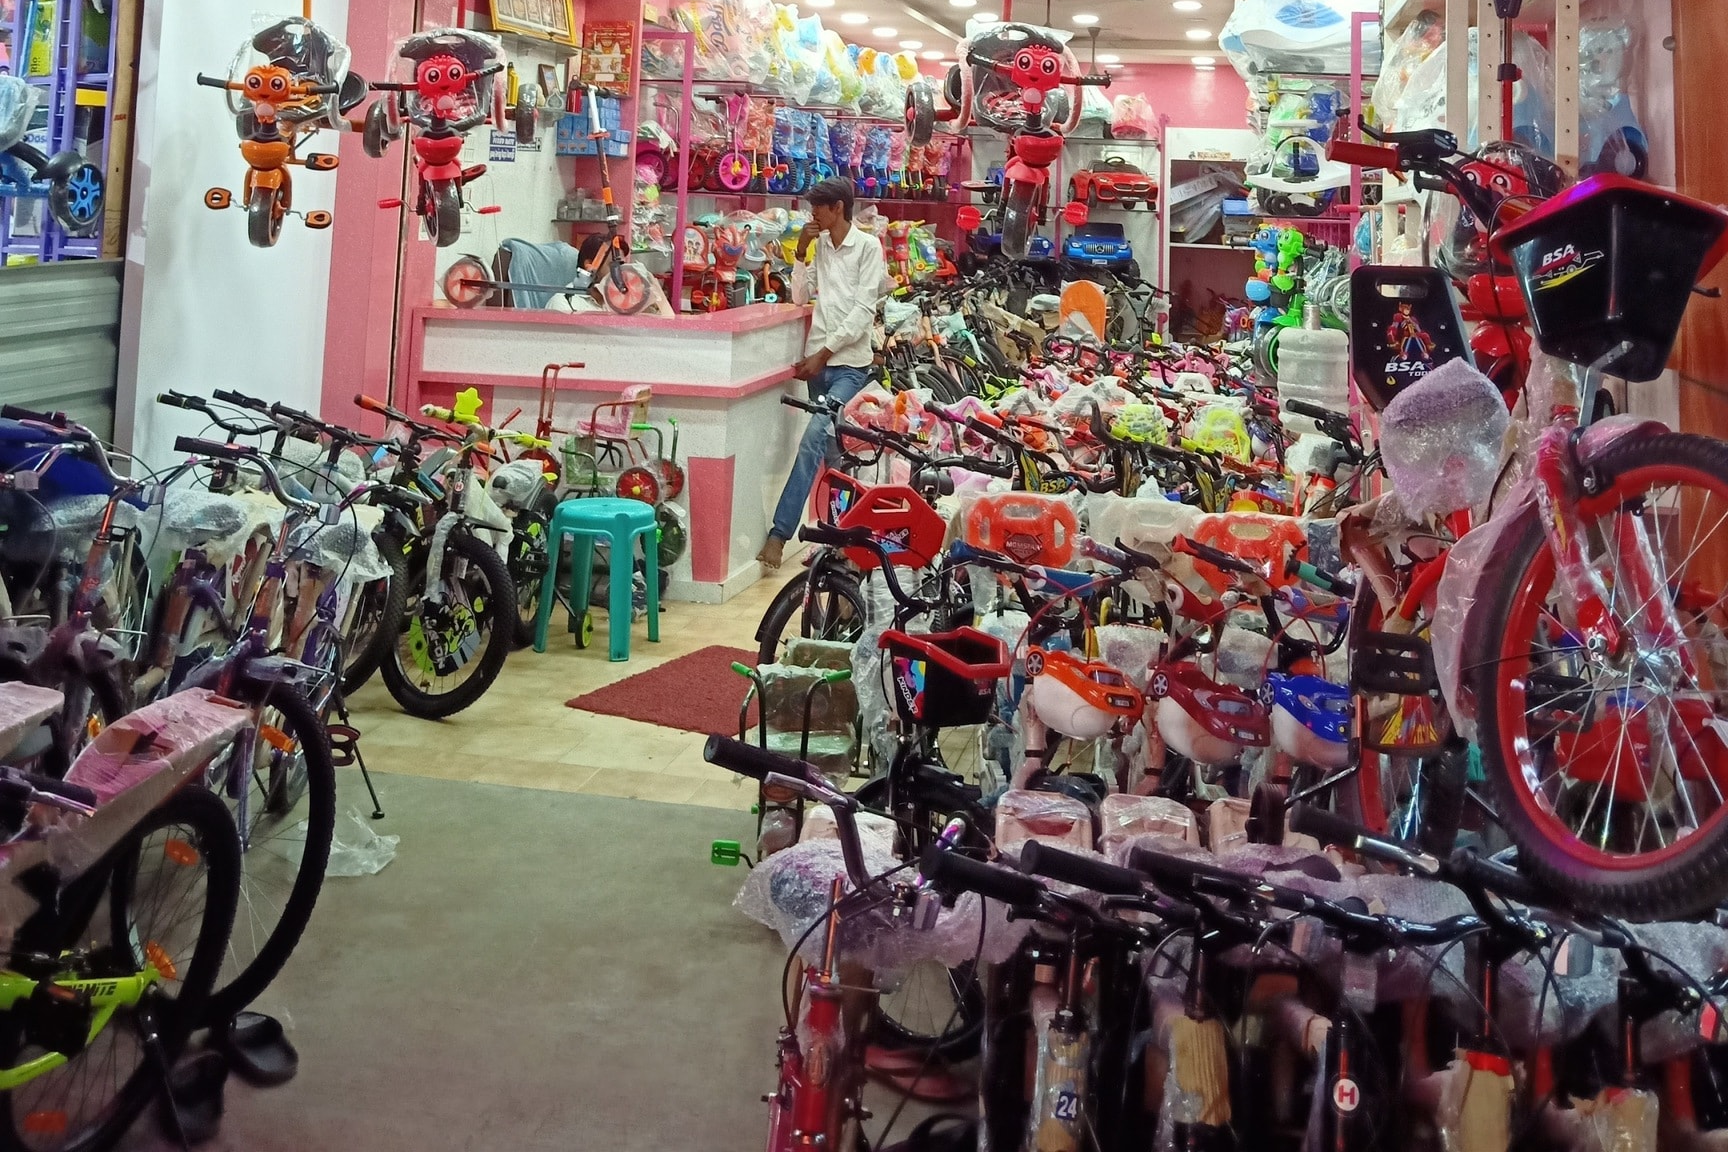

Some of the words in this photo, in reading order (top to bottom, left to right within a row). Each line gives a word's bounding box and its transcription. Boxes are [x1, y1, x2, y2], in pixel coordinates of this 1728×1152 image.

[27, 133, 48, 144] Das
[1542, 243, 1575, 267] BSA
[1385, 360, 1426, 374] BSA
[1040, 478, 1067, 494] BSA
[1057, 1095, 1078, 1118] 24
